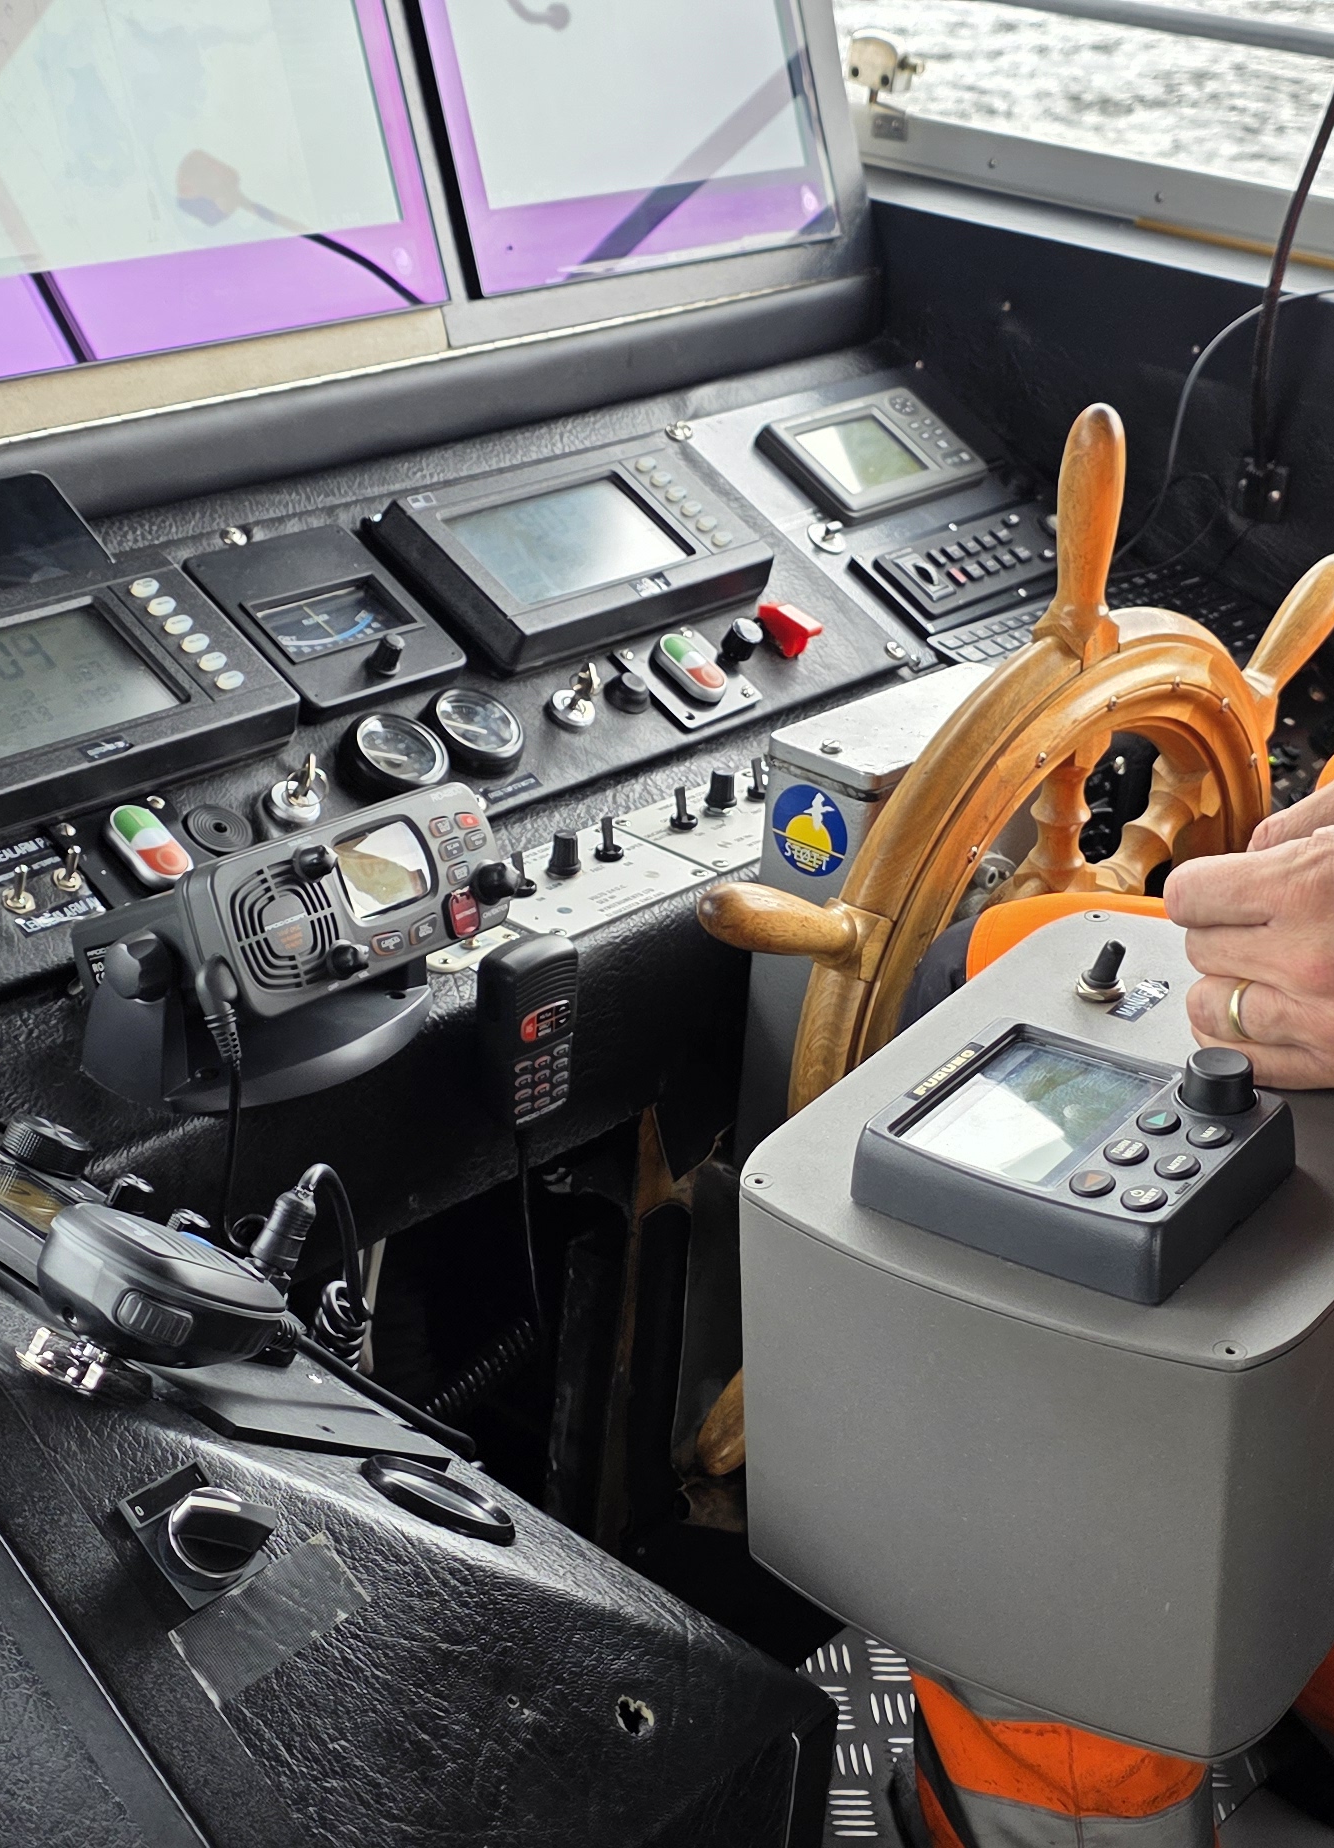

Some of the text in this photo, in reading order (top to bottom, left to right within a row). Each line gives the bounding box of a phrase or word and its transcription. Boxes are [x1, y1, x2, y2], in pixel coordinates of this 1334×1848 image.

[912, 1049, 975, 1097] FURUNO
[1110, 1138, 1132, 1155] TURN
[1121, 1141, 1143, 1159] MENU
[1167, 1155, 1187, 1171] AUTO
